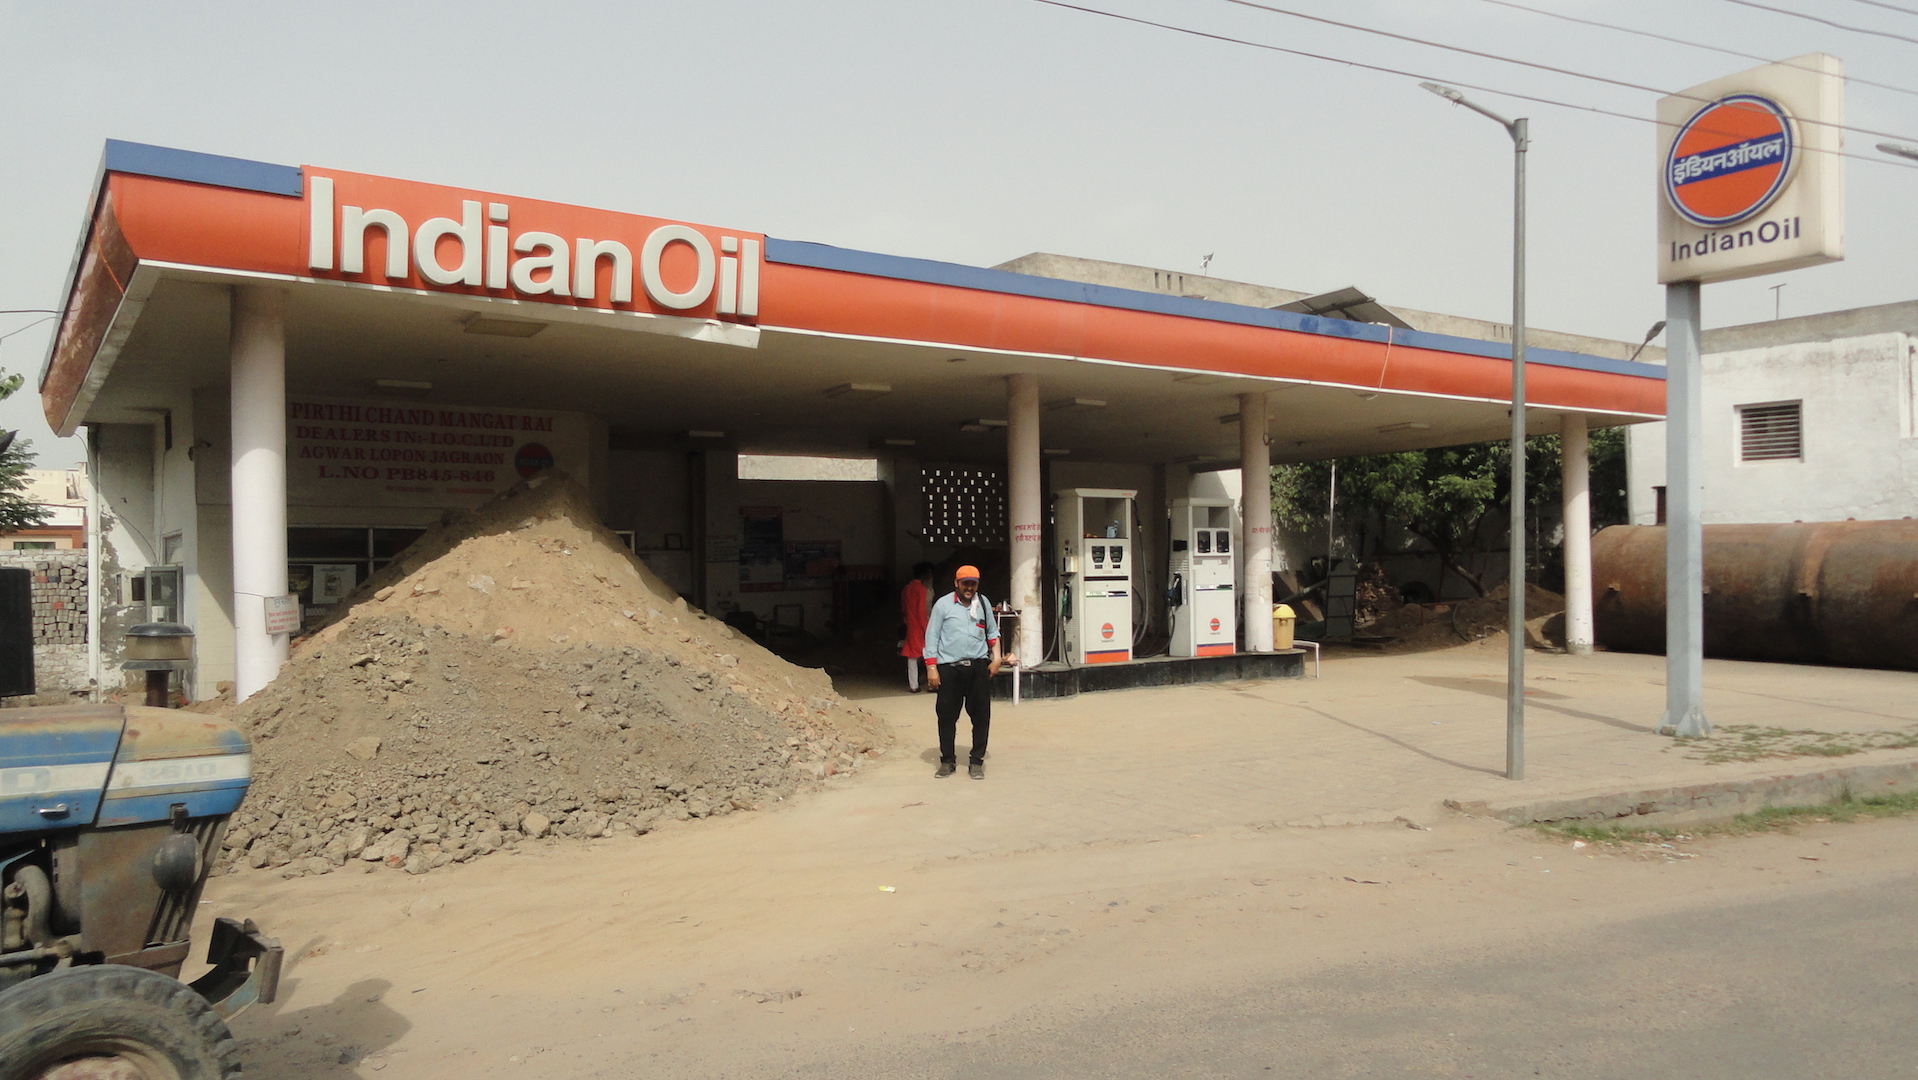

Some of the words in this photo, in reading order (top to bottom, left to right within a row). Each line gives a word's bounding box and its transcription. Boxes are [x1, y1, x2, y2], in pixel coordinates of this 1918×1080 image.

[308, 176, 760, 317] IndianOil
[1671, 216, 1800, 262] IndianOil
[291, 402, 362, 421] PIRTHI
[365, 406, 435, 426] CHAND
[439, 410, 517, 430] MANGAT
[521, 414, 554, 432] RAI
[296, 426, 390, 443] DEALERS
[299, 445, 365, 460] AGWAR
[370, 448, 425, 463] LOPON
[430, 450, 505, 465] JAGRAON
[318, 465, 380, 480] L.NO
[385, 467, 495, 482] PB845-846
